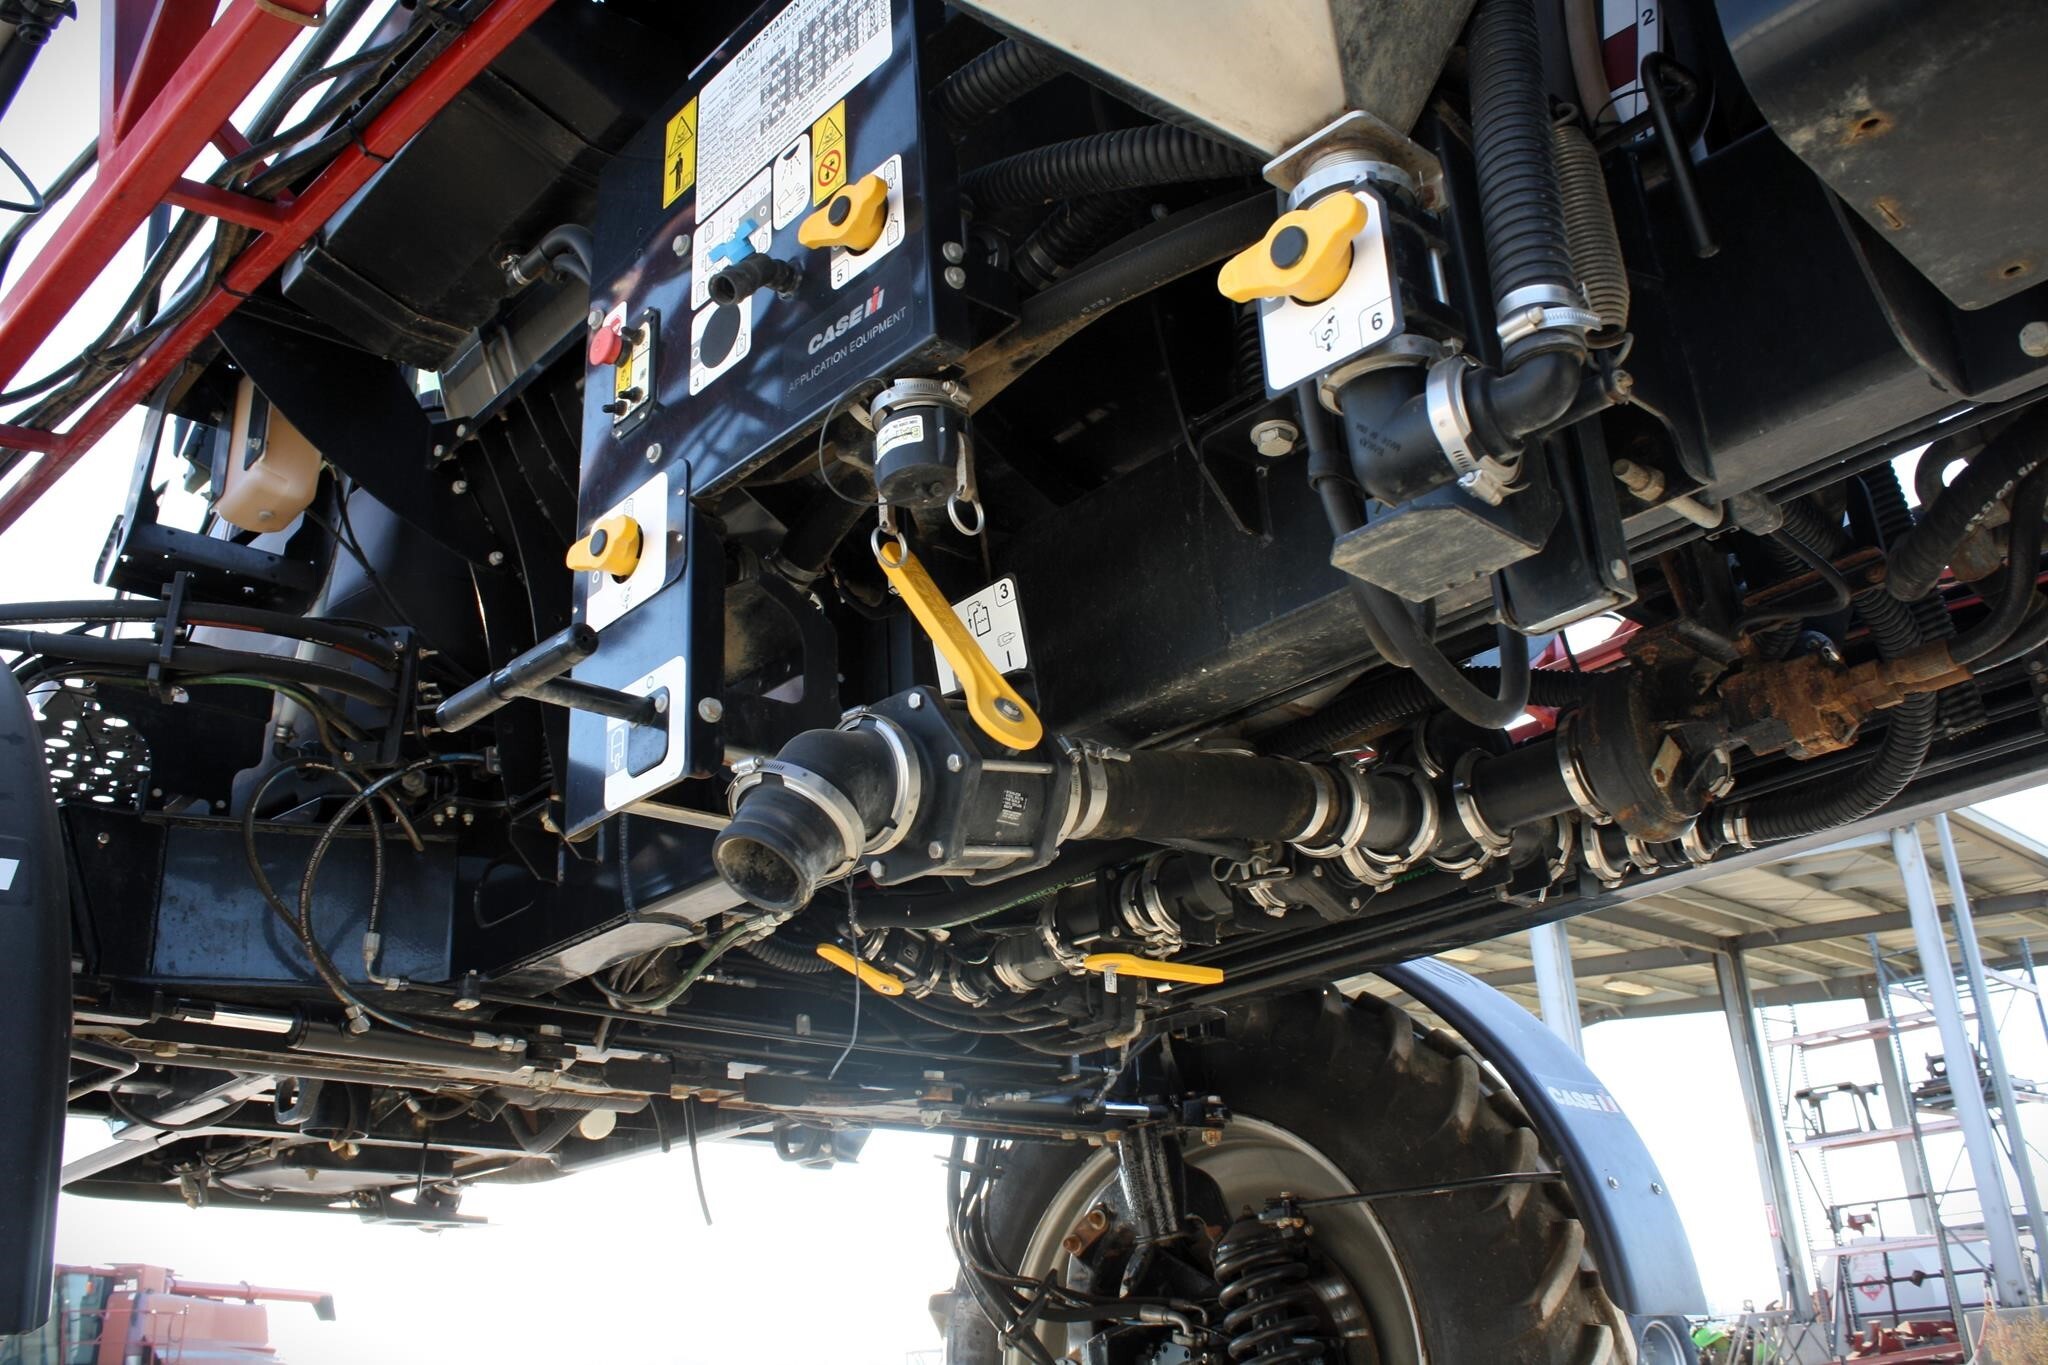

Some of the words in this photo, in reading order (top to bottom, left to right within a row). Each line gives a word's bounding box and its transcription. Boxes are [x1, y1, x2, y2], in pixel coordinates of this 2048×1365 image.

[1641, 8, 1655, 26] 2
[735, 38, 761, 67] PUMP
[763, 0, 800, 40] STATION
[836, 269, 843, 282] 5
[1371, 312, 1383, 330] 6
[788, 346, 848, 395] APPLICATION
[849, 306, 908, 353] EQUIPMENT
[1000, 583, 1009, 600] 3
